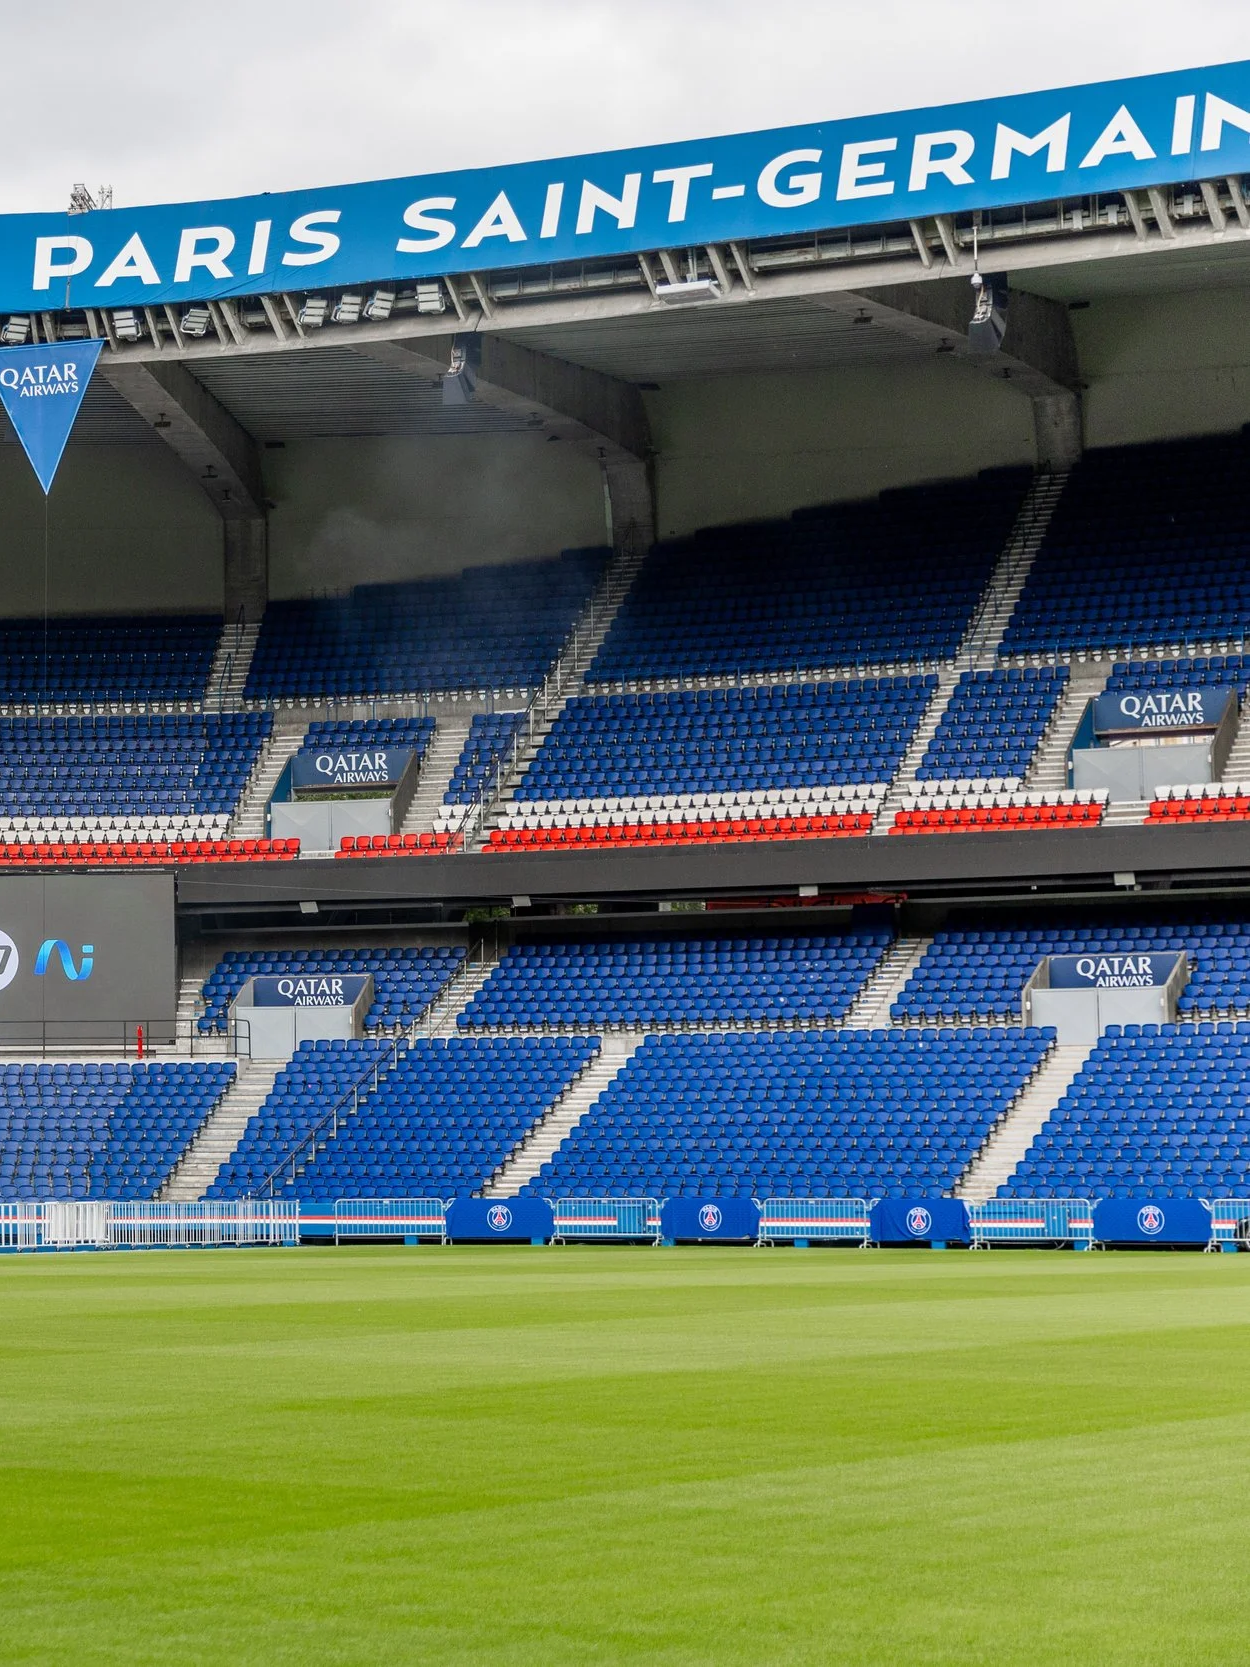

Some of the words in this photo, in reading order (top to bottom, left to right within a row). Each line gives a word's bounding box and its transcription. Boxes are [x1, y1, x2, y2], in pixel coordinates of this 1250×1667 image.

[32, 210, 341, 290] PARIS
[0, 362, 78, 390] QATAR
[20, 381, 79, 397] AIRWAYS
[1119, 692, 1204, 719] QATAR
[1141, 712, 1204, 727] AIRWAYS
[315, 752, 388, 776] QATAR
[334, 771, 389, 784] AIRWAYS
[1076, 956, 1153, 980] QATAR
[277, 978, 344, 999] QATAR
[1096, 975, 1154, 987] AIRWAYS
[294, 995, 344, 1006] AIRWAYS
